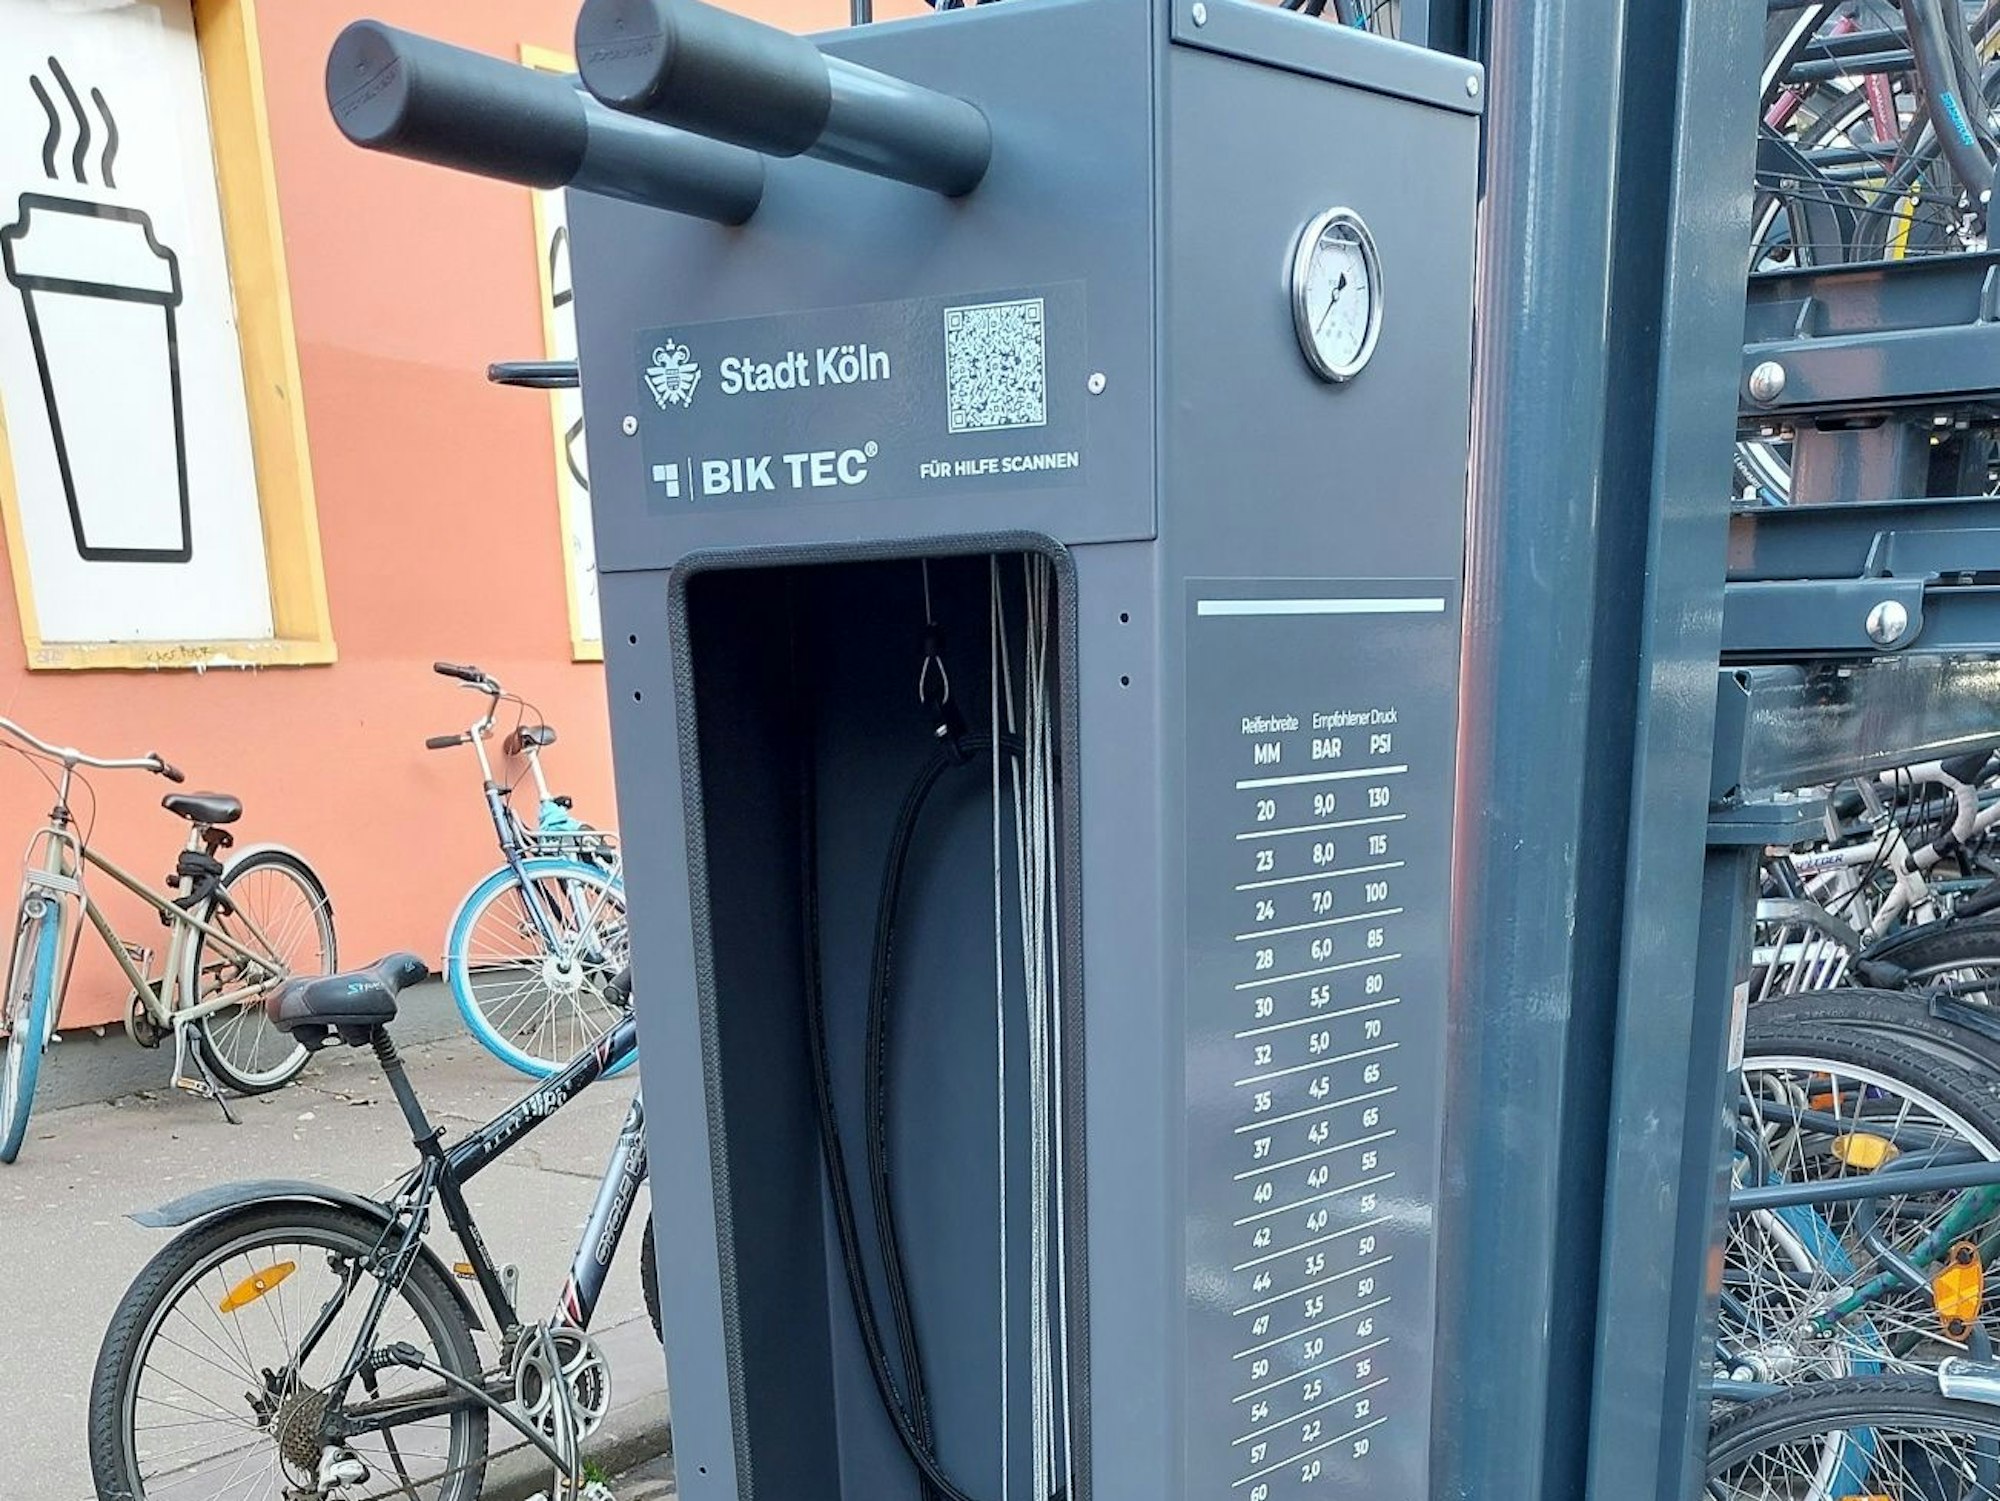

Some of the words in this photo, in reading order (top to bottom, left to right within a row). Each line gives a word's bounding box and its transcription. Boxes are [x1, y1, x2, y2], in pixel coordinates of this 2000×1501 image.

[720, 352, 811, 395] Stadt
[816, 343, 890, 386] Köln
[701, 455, 776, 495] BIK
[919, 459, 952, 479] FÜR
[953, 457, 1000, 477] HILFE
[1001, 451, 1079, 474] SCANNEN
[1241, 714, 1299, 735] Reifenbreite
[1312, 708, 1371, 732] Empfohlener
[1370, 706, 1398, 725] Druck
[1254, 741, 1281, 765] MM
[1311, 737, 1342, 760] BAR
[1369, 732, 1392, 755] PSI
[1256, 799, 1276, 822] 20
[1313, 793, 1335, 818] 9,0
[1367, 786, 1390, 808] 130
[1255, 850, 1274, 872] 23
[1312, 842, 1335, 867] 8,0
[1368, 834, 1388, 856] 115
[1255, 899, 1275, 922] 24
[1312, 890, 1333, 915] 7,0
[1365, 881, 1388, 903] 100
[1255, 948, 1274, 971] 28
[1311, 938, 1333, 962] 6,0
[1366, 927, 1384, 949] 85
[1254, 996, 1274, 1019] 30
[1310, 984, 1330, 1009] 5,5
[1365, 973, 1383, 994] 80
[1254, 1044, 1272, 1066] 32
[1309, 1030, 1330, 1055] 5,0
[1364, 1019, 1382, 1040] 70
[1254, 1090, 1272, 1113] 35
[1308, 1076, 1330, 1100] 4,5
[1363, 1063, 1380, 1084] 65
[1253, 1136, 1272, 1159] 37
[1307, 1120, 1329, 1146] 4,5
[1362, 1107, 1379, 1128] 65
[1253, 1182, 1273, 1204] 40
[1307, 1165, 1329, 1189] 4,0
[1361, 1150, 1377, 1171] 55
[1252, 1227, 1271, 1248] 42
[1306, 1209, 1328, 1233] 4,0
[1360, 1193, 1376, 1214] 55
[1252, 1271, 1272, 1292] 44
[1304, 1252, 1325, 1276] 3,5
[1358, 1235, 1376, 1256] 50
[1251, 1314, 1270, 1336] 47
[1304, 1294, 1324, 1319] 3,5
[1357, 1277, 1374, 1298] 50
[1251, 1358, 1269, 1380] 50
[1303, 1337, 1324, 1361] 3,0
[1356, 1317, 1373, 1337] 45
[1251, 1400, 1269, 1422] 54
[1303, 1378, 1322, 1402] 2,5
[1355, 1357, 1371, 1379] 35
[1250, 1442, 1267, 1464] 57
[1301, 1419, 1321, 1442] 2,2
[1354, 1399, 1370, 1419] 32
[1250, 1483, 1268, 1501] 60
[1301, 1459, 1321, 1483] 2,0
[1352, 1438, 1370, 1459] 30
